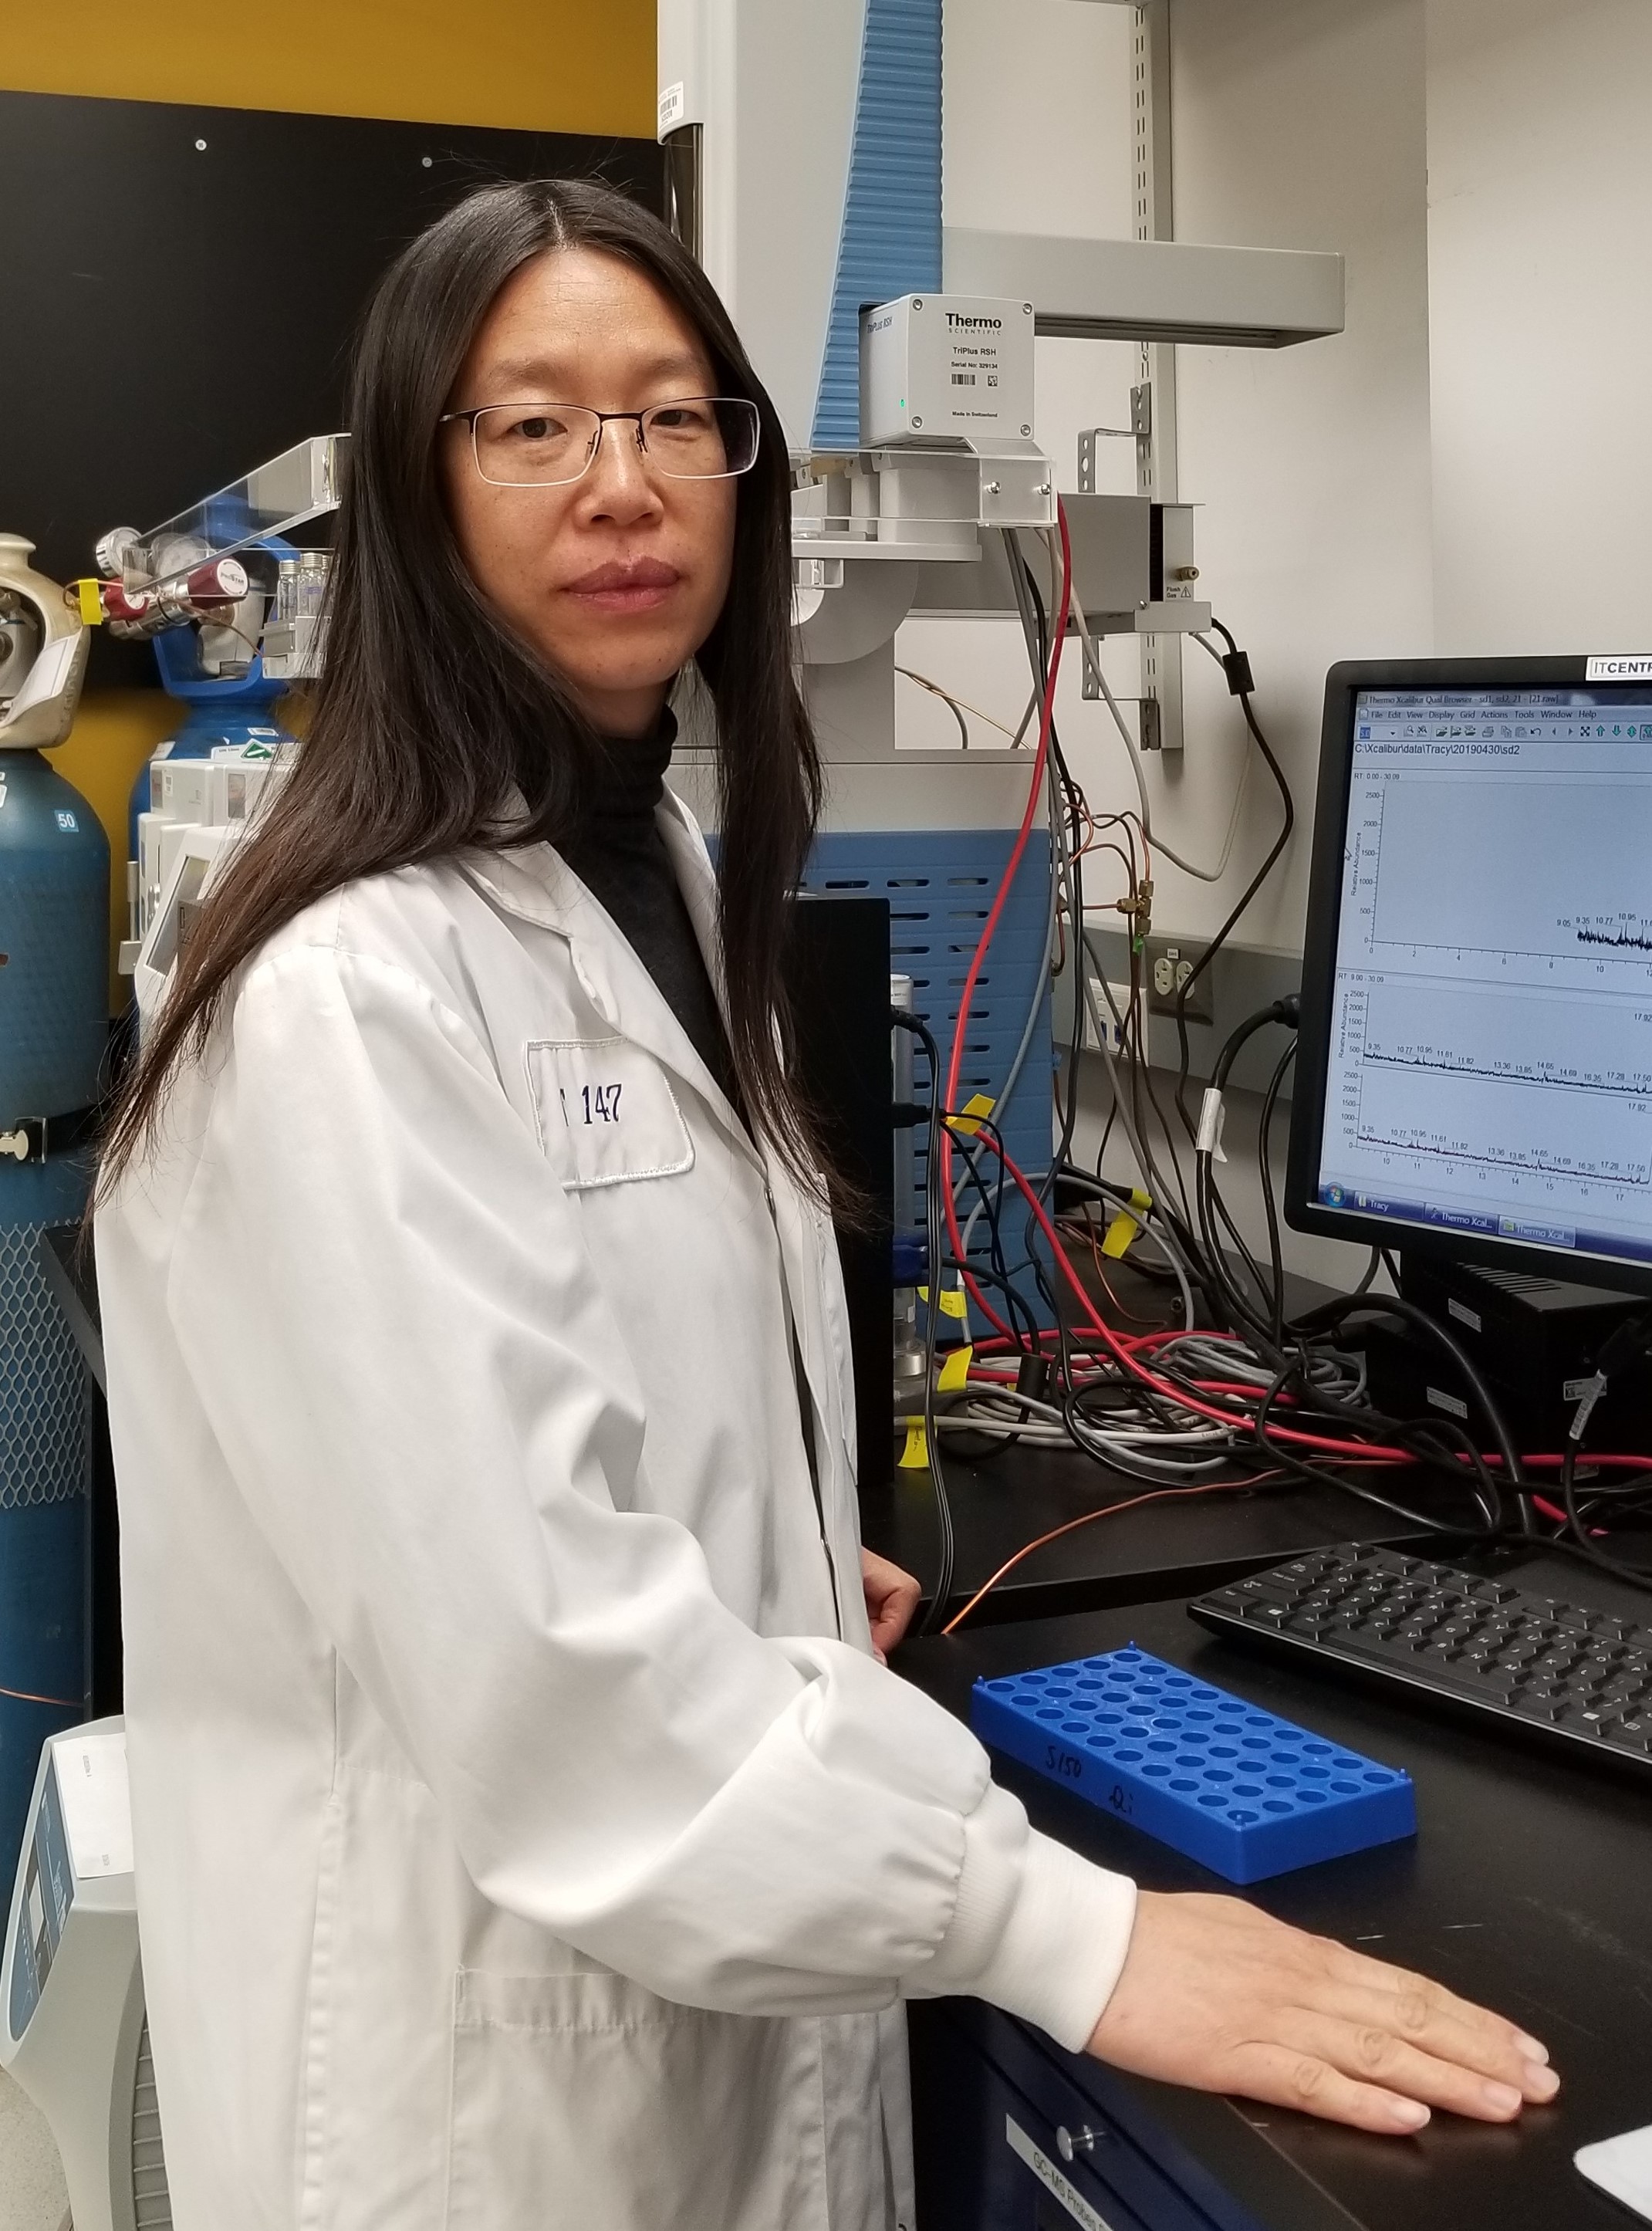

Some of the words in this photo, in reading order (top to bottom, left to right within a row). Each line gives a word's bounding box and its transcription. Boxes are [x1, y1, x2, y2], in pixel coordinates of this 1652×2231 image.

[945, 313, 1002, 329] Thermo
[953, 346, 978, 355] TriPlus
[1429, 712, 1455, 720] Display
[1579, 711, 1596, 719] Help
[58, 813, 75, 828] 50
[581, 1083, 622, 1124] 147
[1370, 1199, 1389, 1212] Tracy
[1441, 1212, 1470, 1225] Thermo
[1516, 1225, 1546, 1238] Thermo
